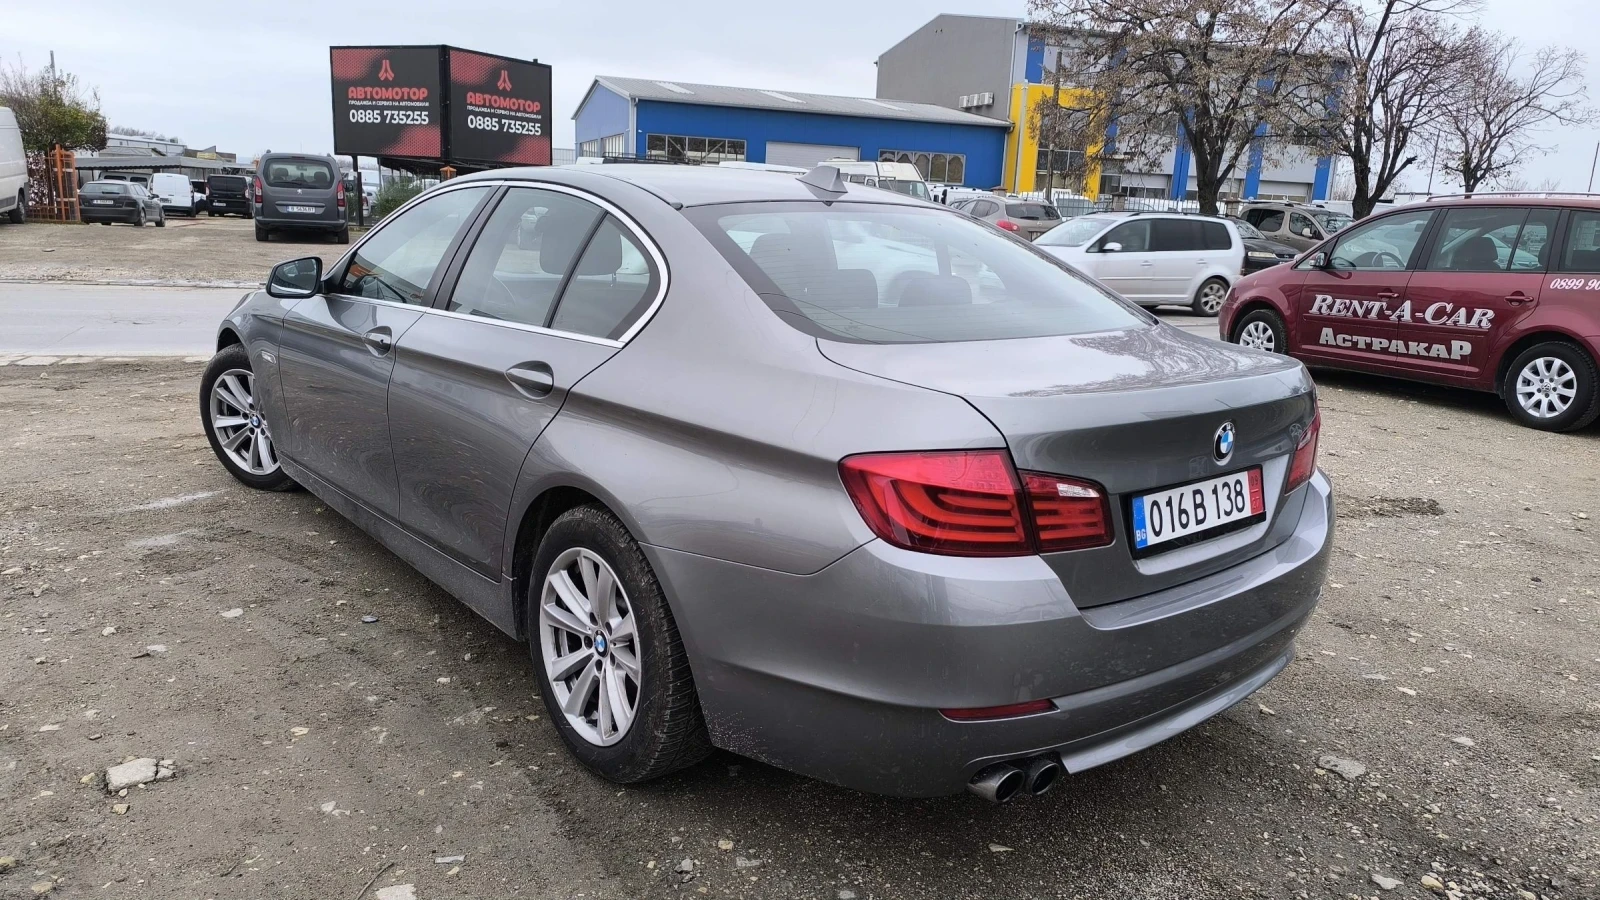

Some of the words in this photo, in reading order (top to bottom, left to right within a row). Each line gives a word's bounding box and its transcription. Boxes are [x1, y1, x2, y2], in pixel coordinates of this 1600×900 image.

[348, 86, 428, 100] АВТОМОТОР
[466, 91, 541, 113] АВТОМОТОР
[349, 109, 381, 123] 0885
[383, 110, 429, 125] 735255
[467, 114, 499, 131] 0885
[501, 118, 542, 136] 735255
[1550, 278, 1585, 290] 0899
[1135, 529, 1147, 542] BG
